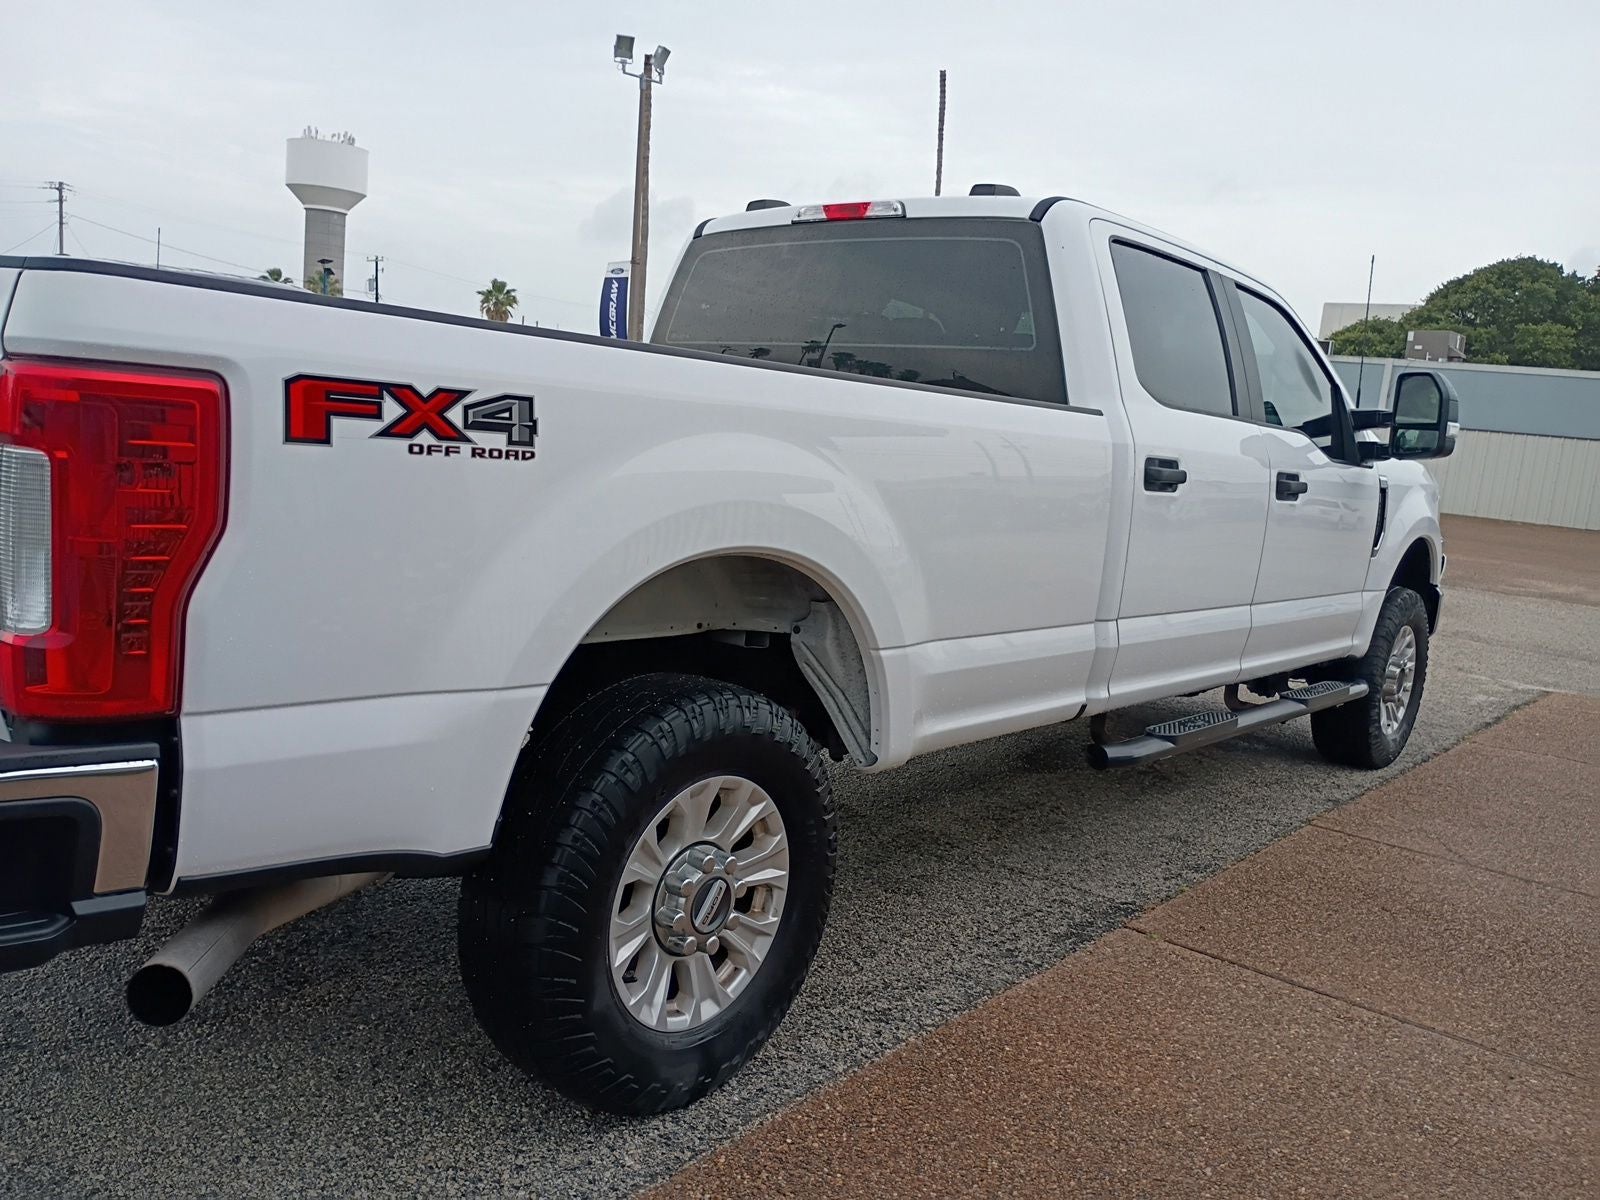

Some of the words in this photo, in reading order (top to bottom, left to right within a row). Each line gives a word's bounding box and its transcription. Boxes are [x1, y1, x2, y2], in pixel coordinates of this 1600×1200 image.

[283, 372, 538, 449] FX4
[408, 443, 461, 458] OFF
[471, 447, 536, 461] ROAD
[702, 887, 722, 925] FORD
